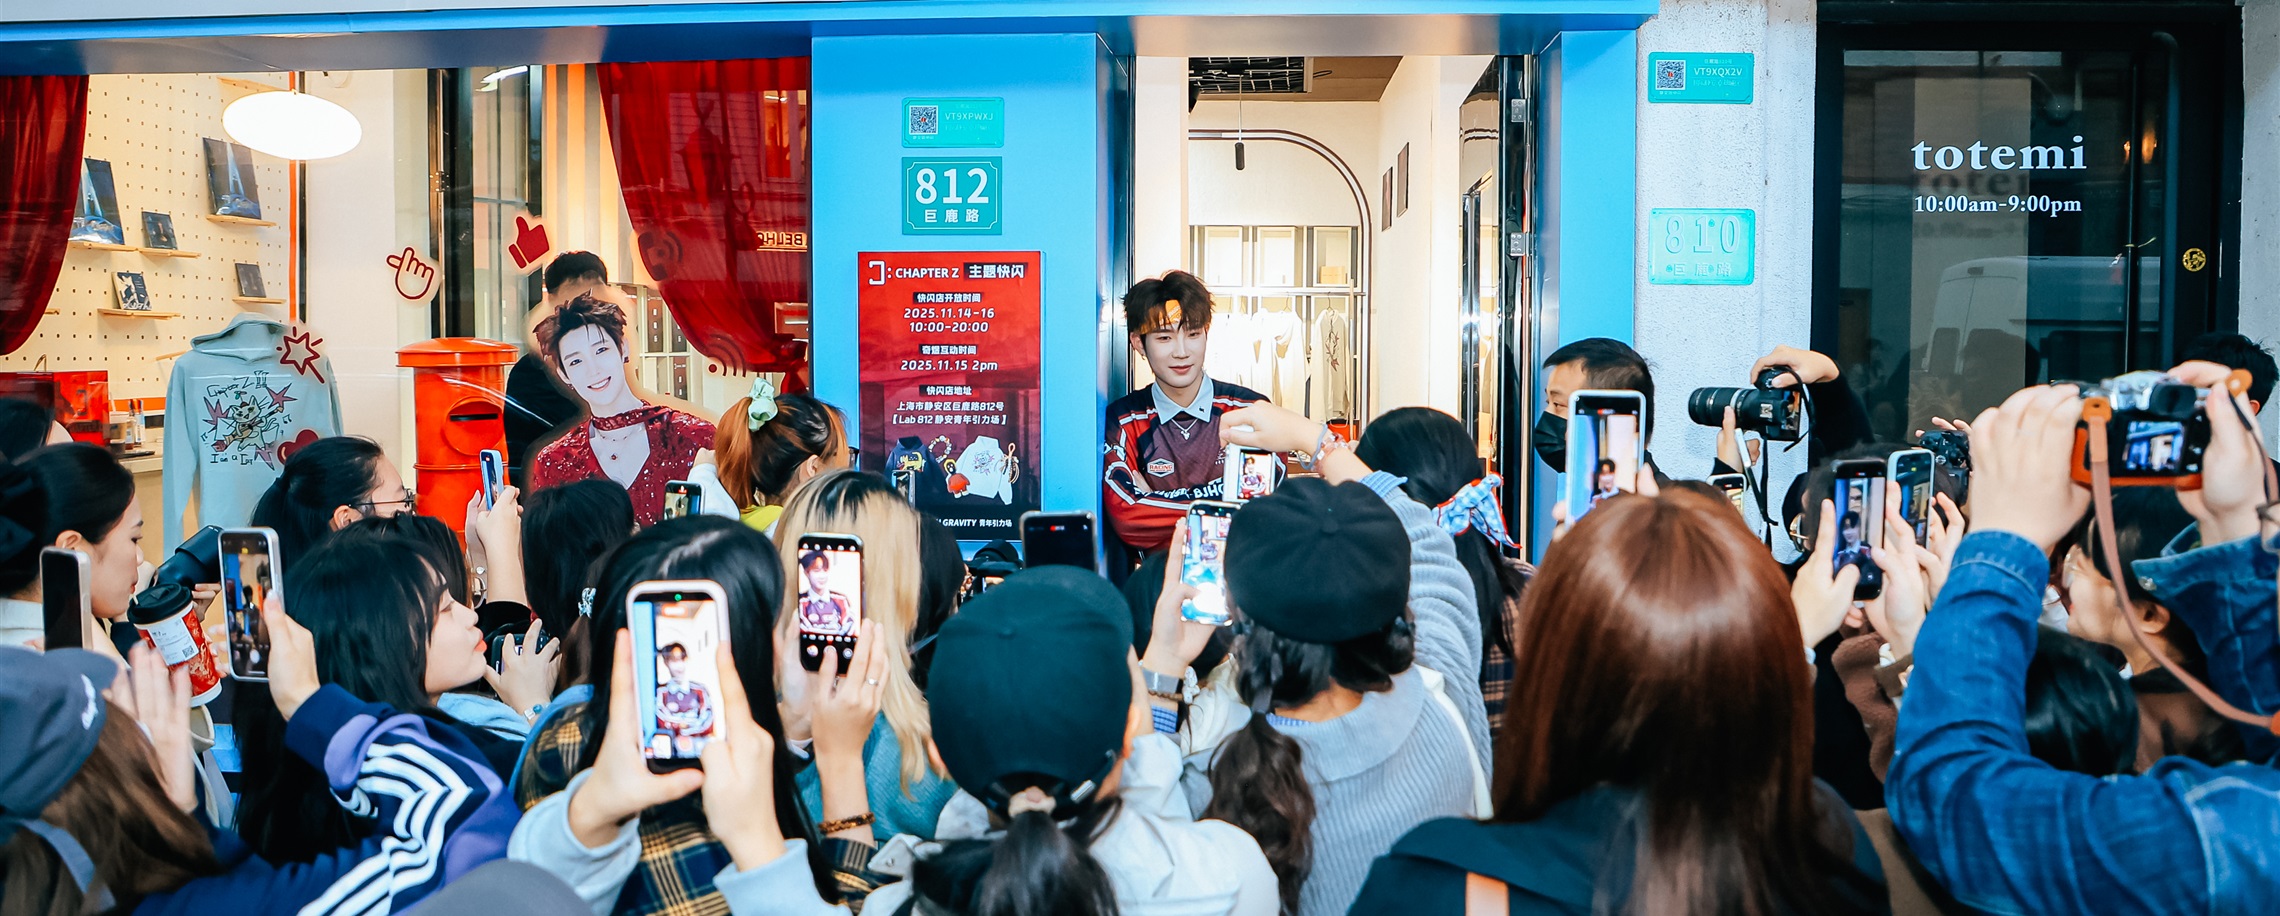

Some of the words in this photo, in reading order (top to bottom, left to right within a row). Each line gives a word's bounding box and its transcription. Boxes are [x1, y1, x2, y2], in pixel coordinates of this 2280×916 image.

[1693, 67, 1743, 78] VT9XQX2V
[944, 112, 994, 121] VT9XPWXJ
[1911, 134, 2087, 171] totemi
[915, 167, 989, 205] 812
[1914, 194, 2082, 218] 10:00am-9:00pm
[924, 208, 980, 223] 巨鹿路
[1665, 215, 1740, 254] 810
[895, 267, 949, 279] CHAPTER
[951, 267, 960, 279] Z
[968, 264, 1025, 279] 主题快闪
[1673, 262, 1732, 277] 巨鹿路
[917, 293, 981, 303] 快闪店开放时间
[903, 307, 995, 319] 2025.11.14-16
[909, 321, 989, 333] 10:00-20:00
[900, 360, 968, 371] 2025.11.15
[971, 360, 998, 373] 2pm
[926, 386, 972, 396] 快闪店地址
[896, 401, 1005, 412] 上海市静安区巨鹿路812号
[942, 519, 977, 527] GRAVITY
[979, 519, 1013, 528] 青年引力场
